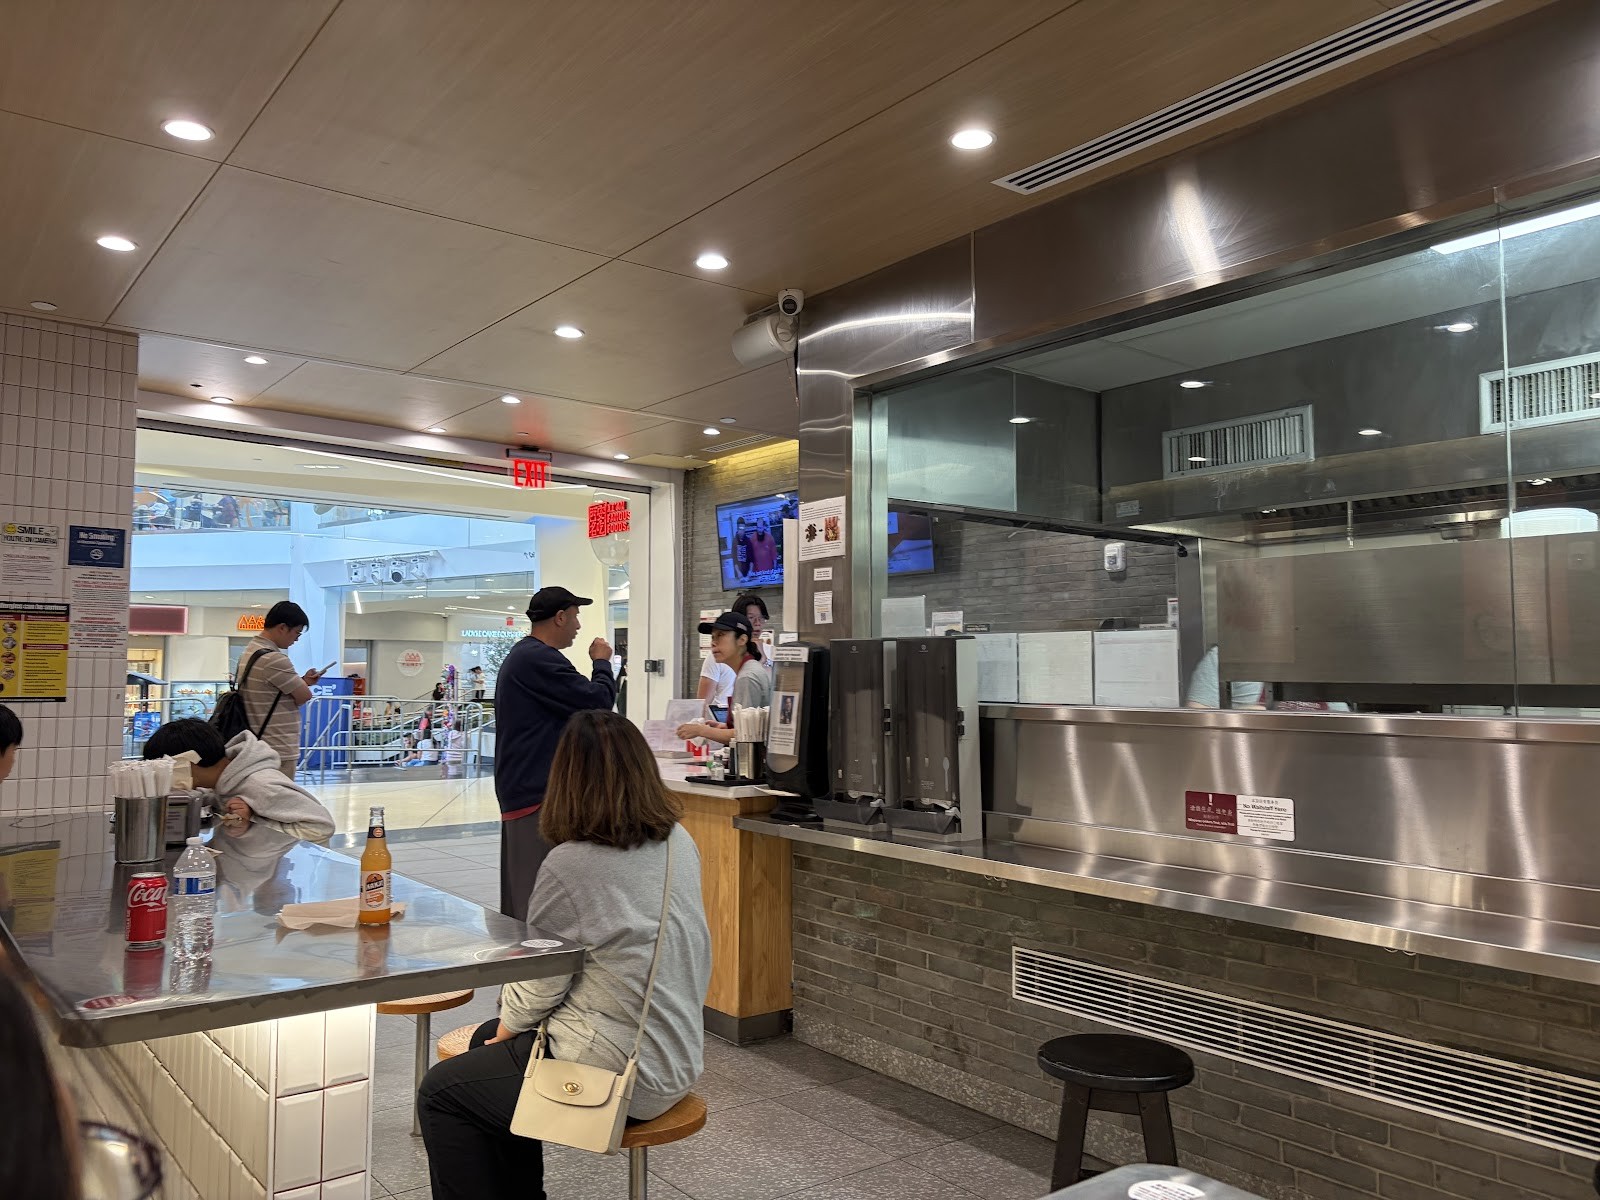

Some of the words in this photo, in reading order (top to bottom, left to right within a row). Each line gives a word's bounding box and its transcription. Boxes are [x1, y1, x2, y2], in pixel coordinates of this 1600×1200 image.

[514, 459, 549, 488] EXIT
[607, 510, 630, 522] FAMOUS
[17, 525, 45, 535] SMILE
[89, 532, 115, 542] Smoking
